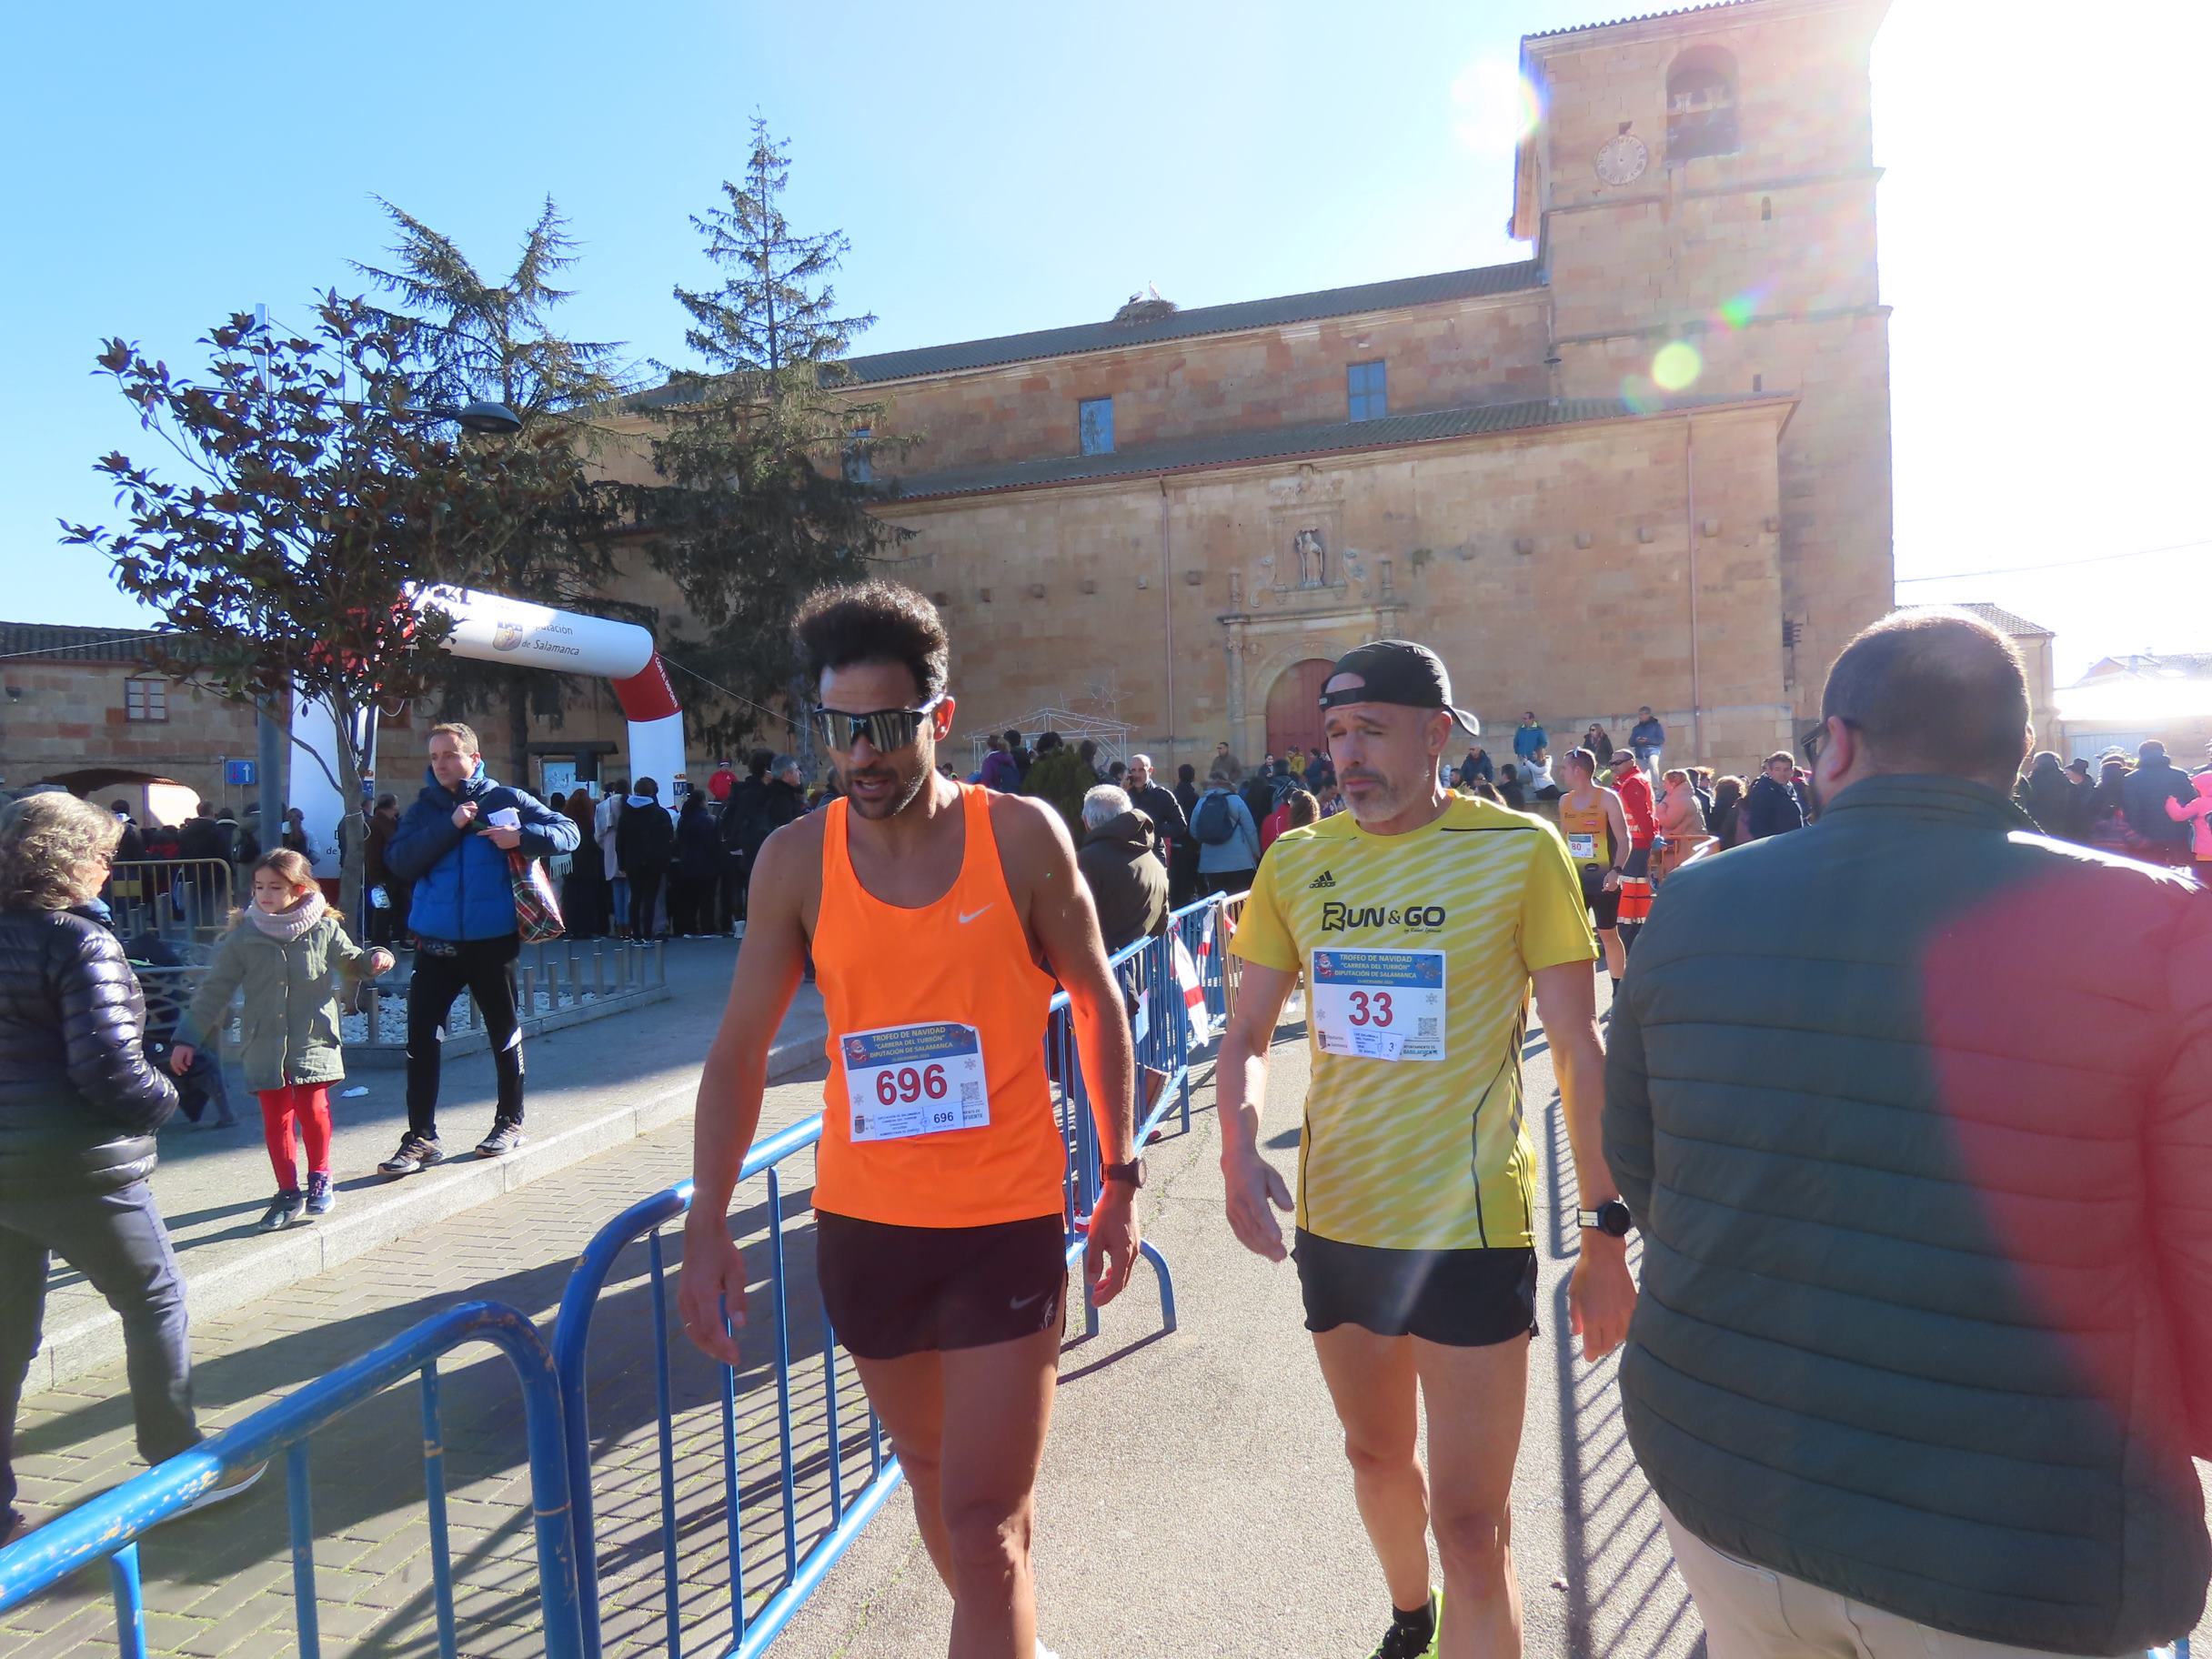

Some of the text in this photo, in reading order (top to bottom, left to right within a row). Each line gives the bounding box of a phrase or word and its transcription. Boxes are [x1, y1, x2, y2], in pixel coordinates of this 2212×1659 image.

[521, 638, 580, 656] de Salamanca
[326, 846, 337, 855] de
[1571, 842, 1582, 851] 80
[1309, 880, 1336, 889] adidas
[1322, 901, 1446, 932] RUN & GO
[1339, 953, 1366, 961] TROFEO
[1368, 954, 1378, 962] DE
[1348, 990, 1393, 1028] 33
[872, 1026, 946, 1042] TROFEO DE NAVIDAD
[914, 1042, 953, 1051] SALAMANCA
[876, 1063, 948, 1106] 696
[933, 1111, 954, 1124] 696
